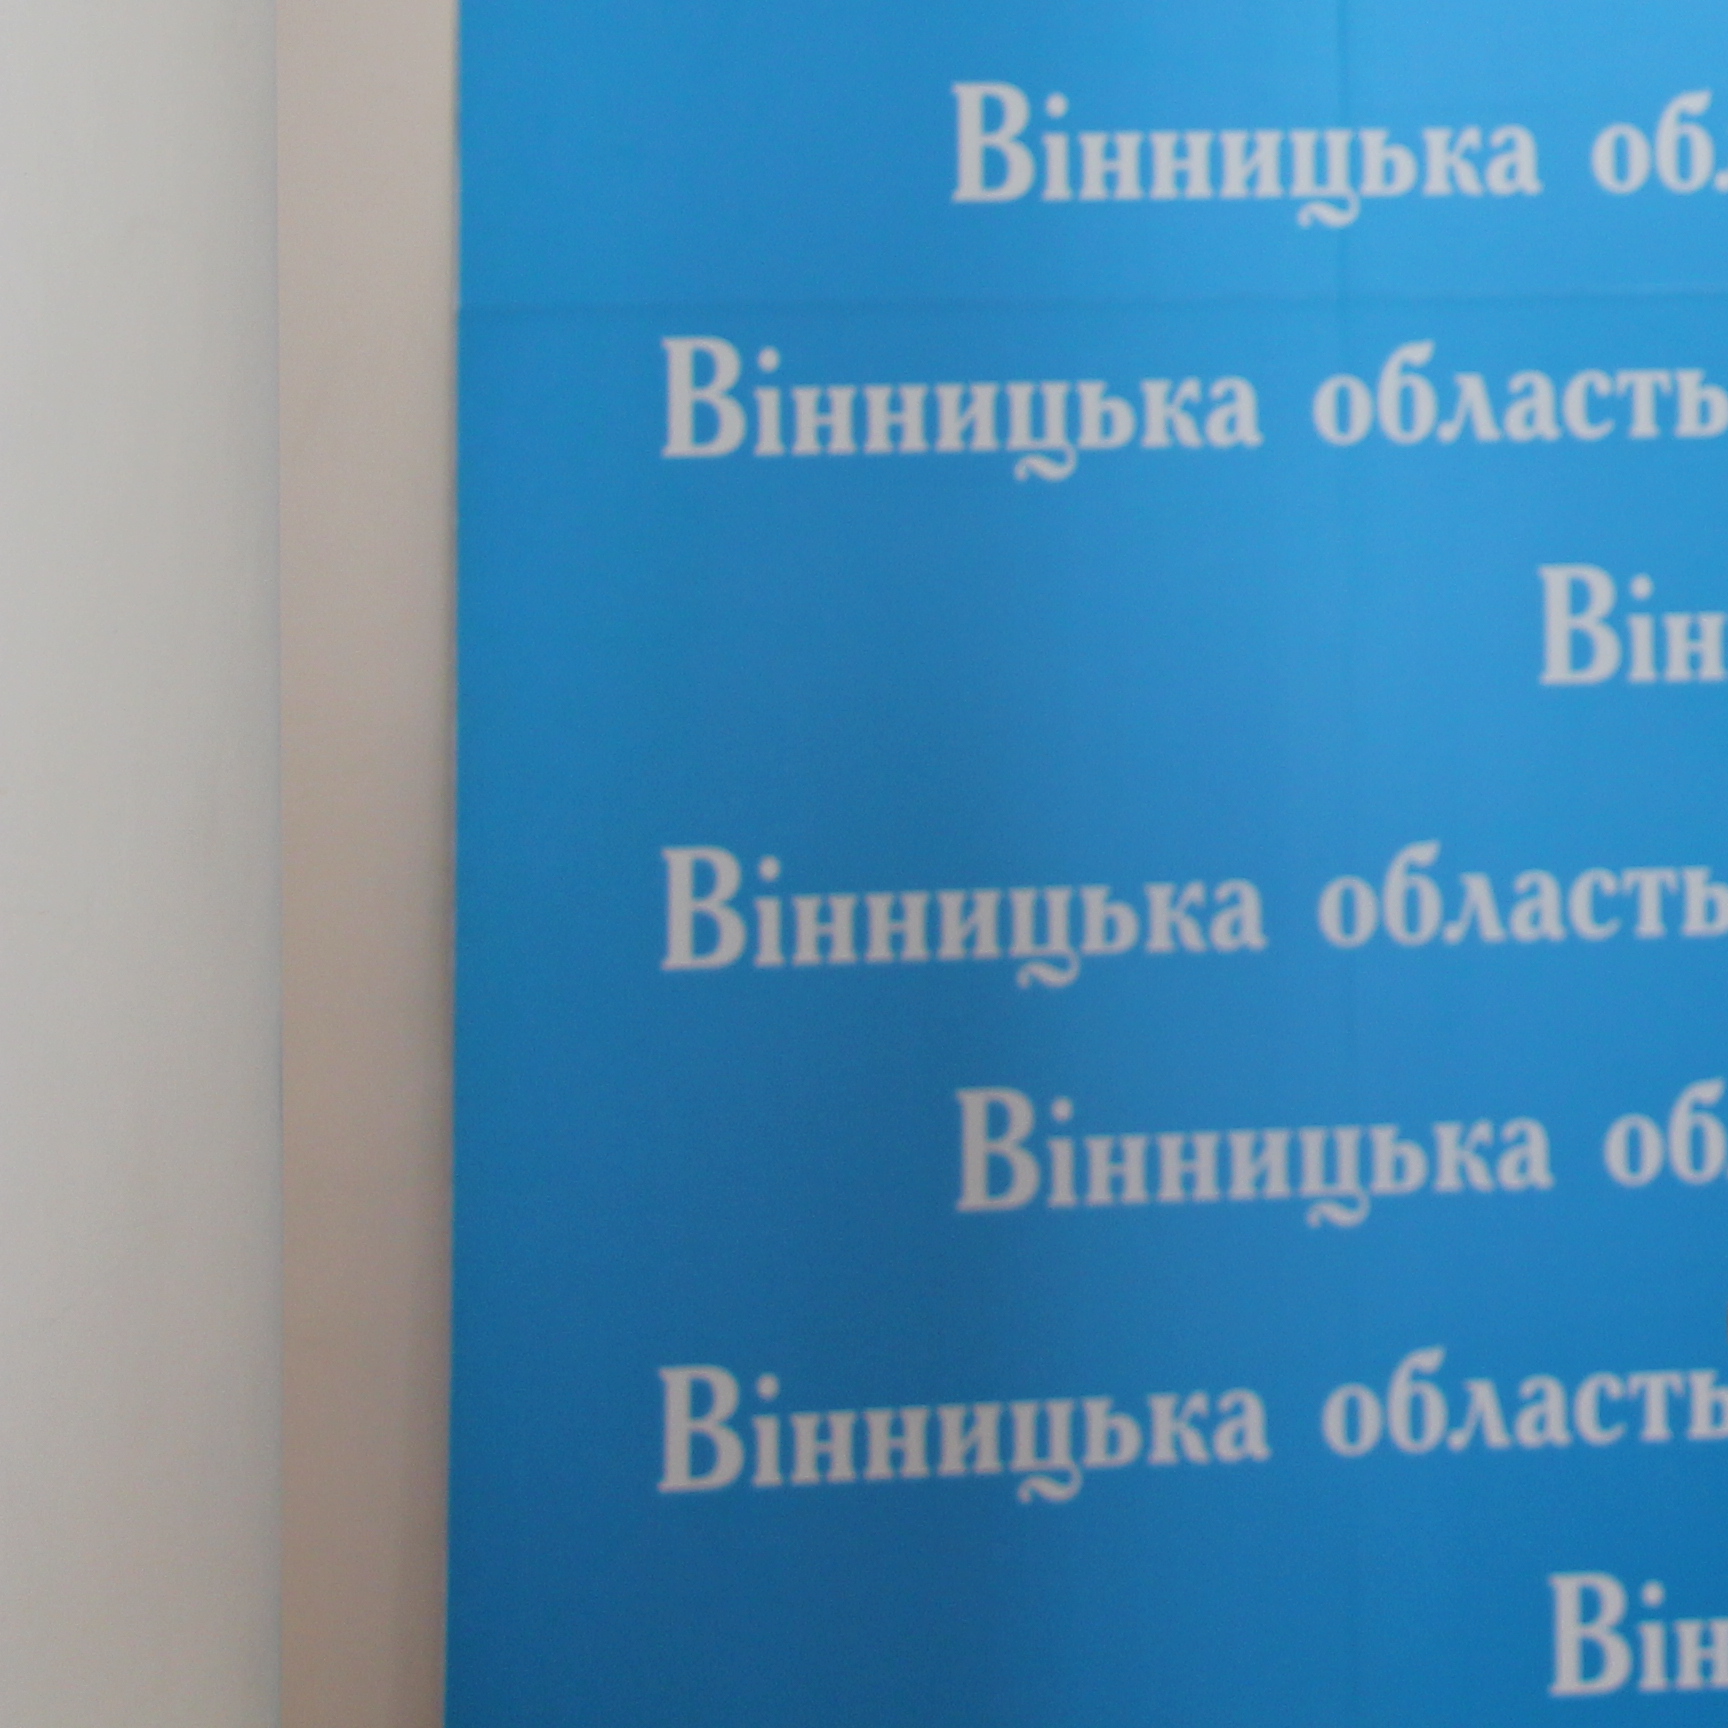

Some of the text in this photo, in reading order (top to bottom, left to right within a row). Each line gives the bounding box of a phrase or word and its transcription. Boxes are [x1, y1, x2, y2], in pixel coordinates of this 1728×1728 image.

[954, 84, 1541, 226] Вінницька
[664, 338, 1261, 479] Вінницька
[665, 849, 1265, 985] Вінницька
[961, 1092, 1551, 1225] Вінницька
[661, 1369, 1267, 1499] Вінницька
